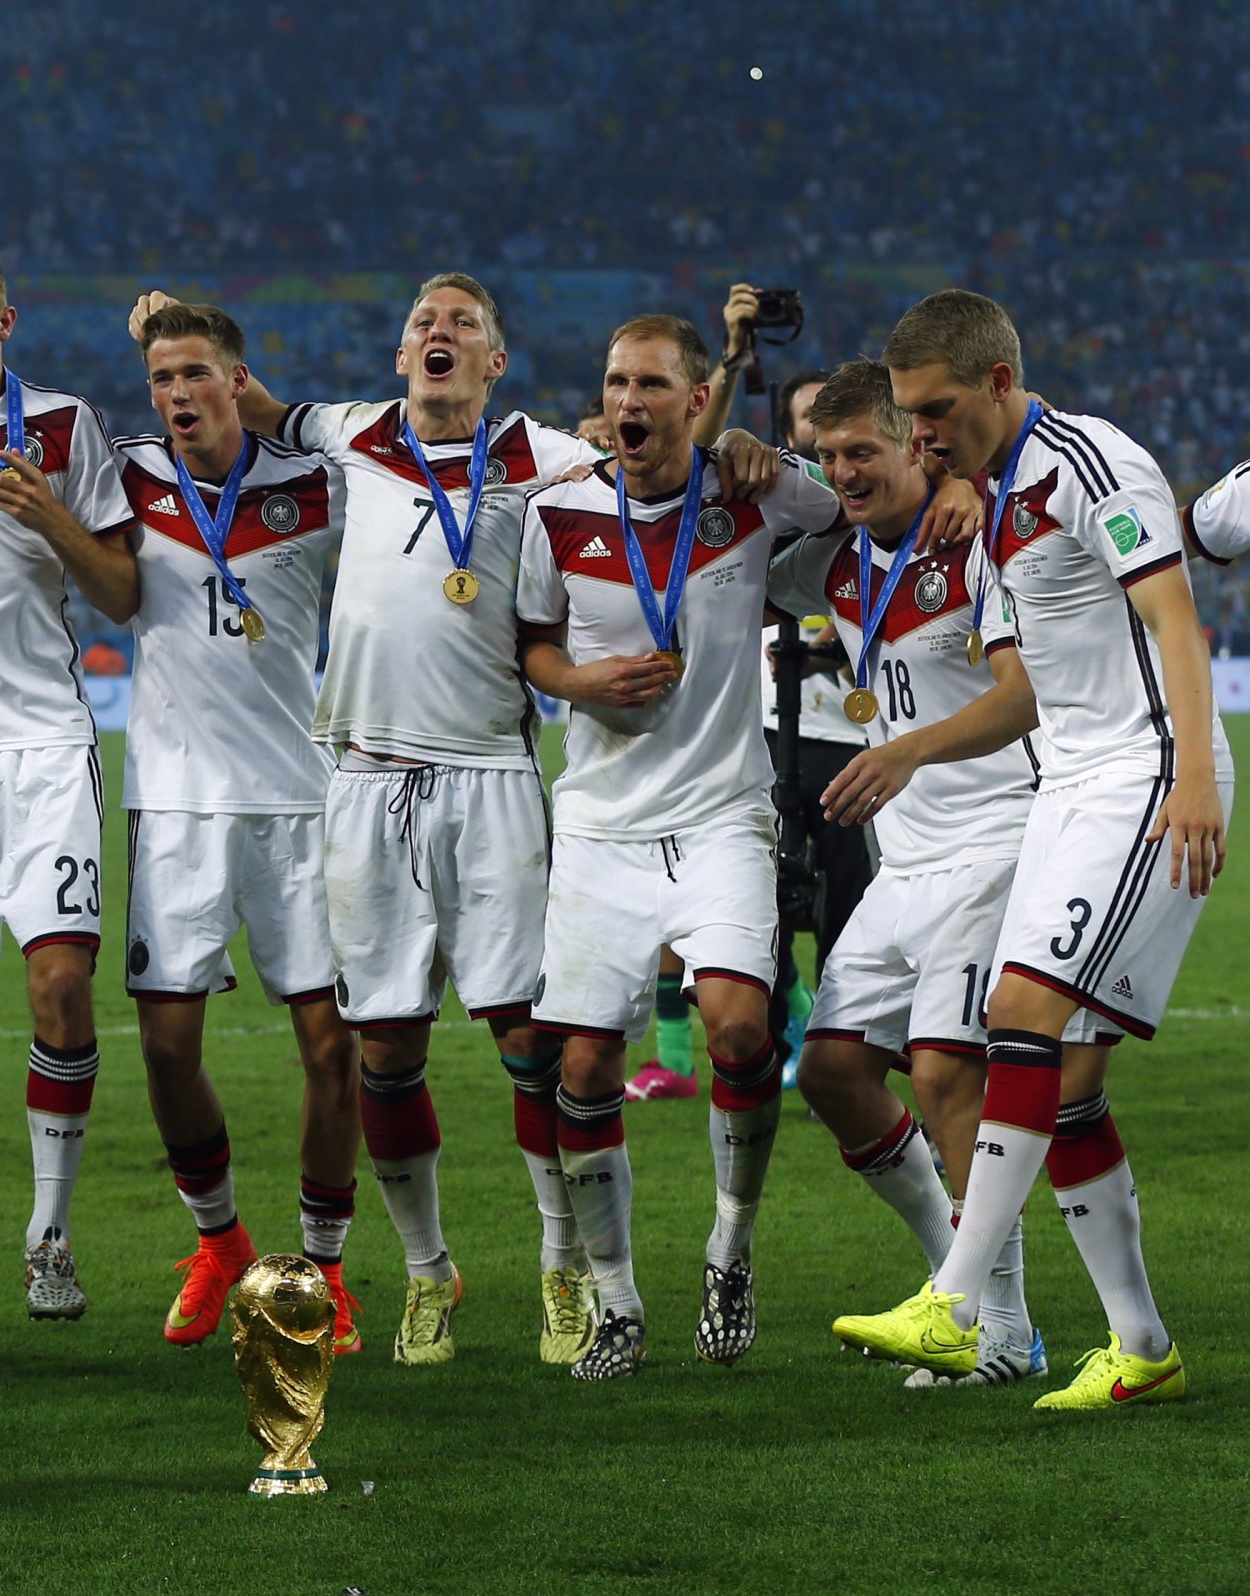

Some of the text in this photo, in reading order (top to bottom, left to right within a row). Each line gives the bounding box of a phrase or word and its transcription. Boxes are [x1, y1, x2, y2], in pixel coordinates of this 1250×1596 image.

[147, 504, 180, 516] adidas
[403, 498, 437, 554] 7
[579, 549, 612, 558] adidas
[202, 576, 247, 637] 15
[834, 590, 859, 601] adidas
[880, 659, 916, 721] 18
[55, 856, 100, 917] 23
[1050, 898, 1092, 960] 3
[45, 1127, 84, 1139] DFB
[565, 1172, 613, 1186] DFB
